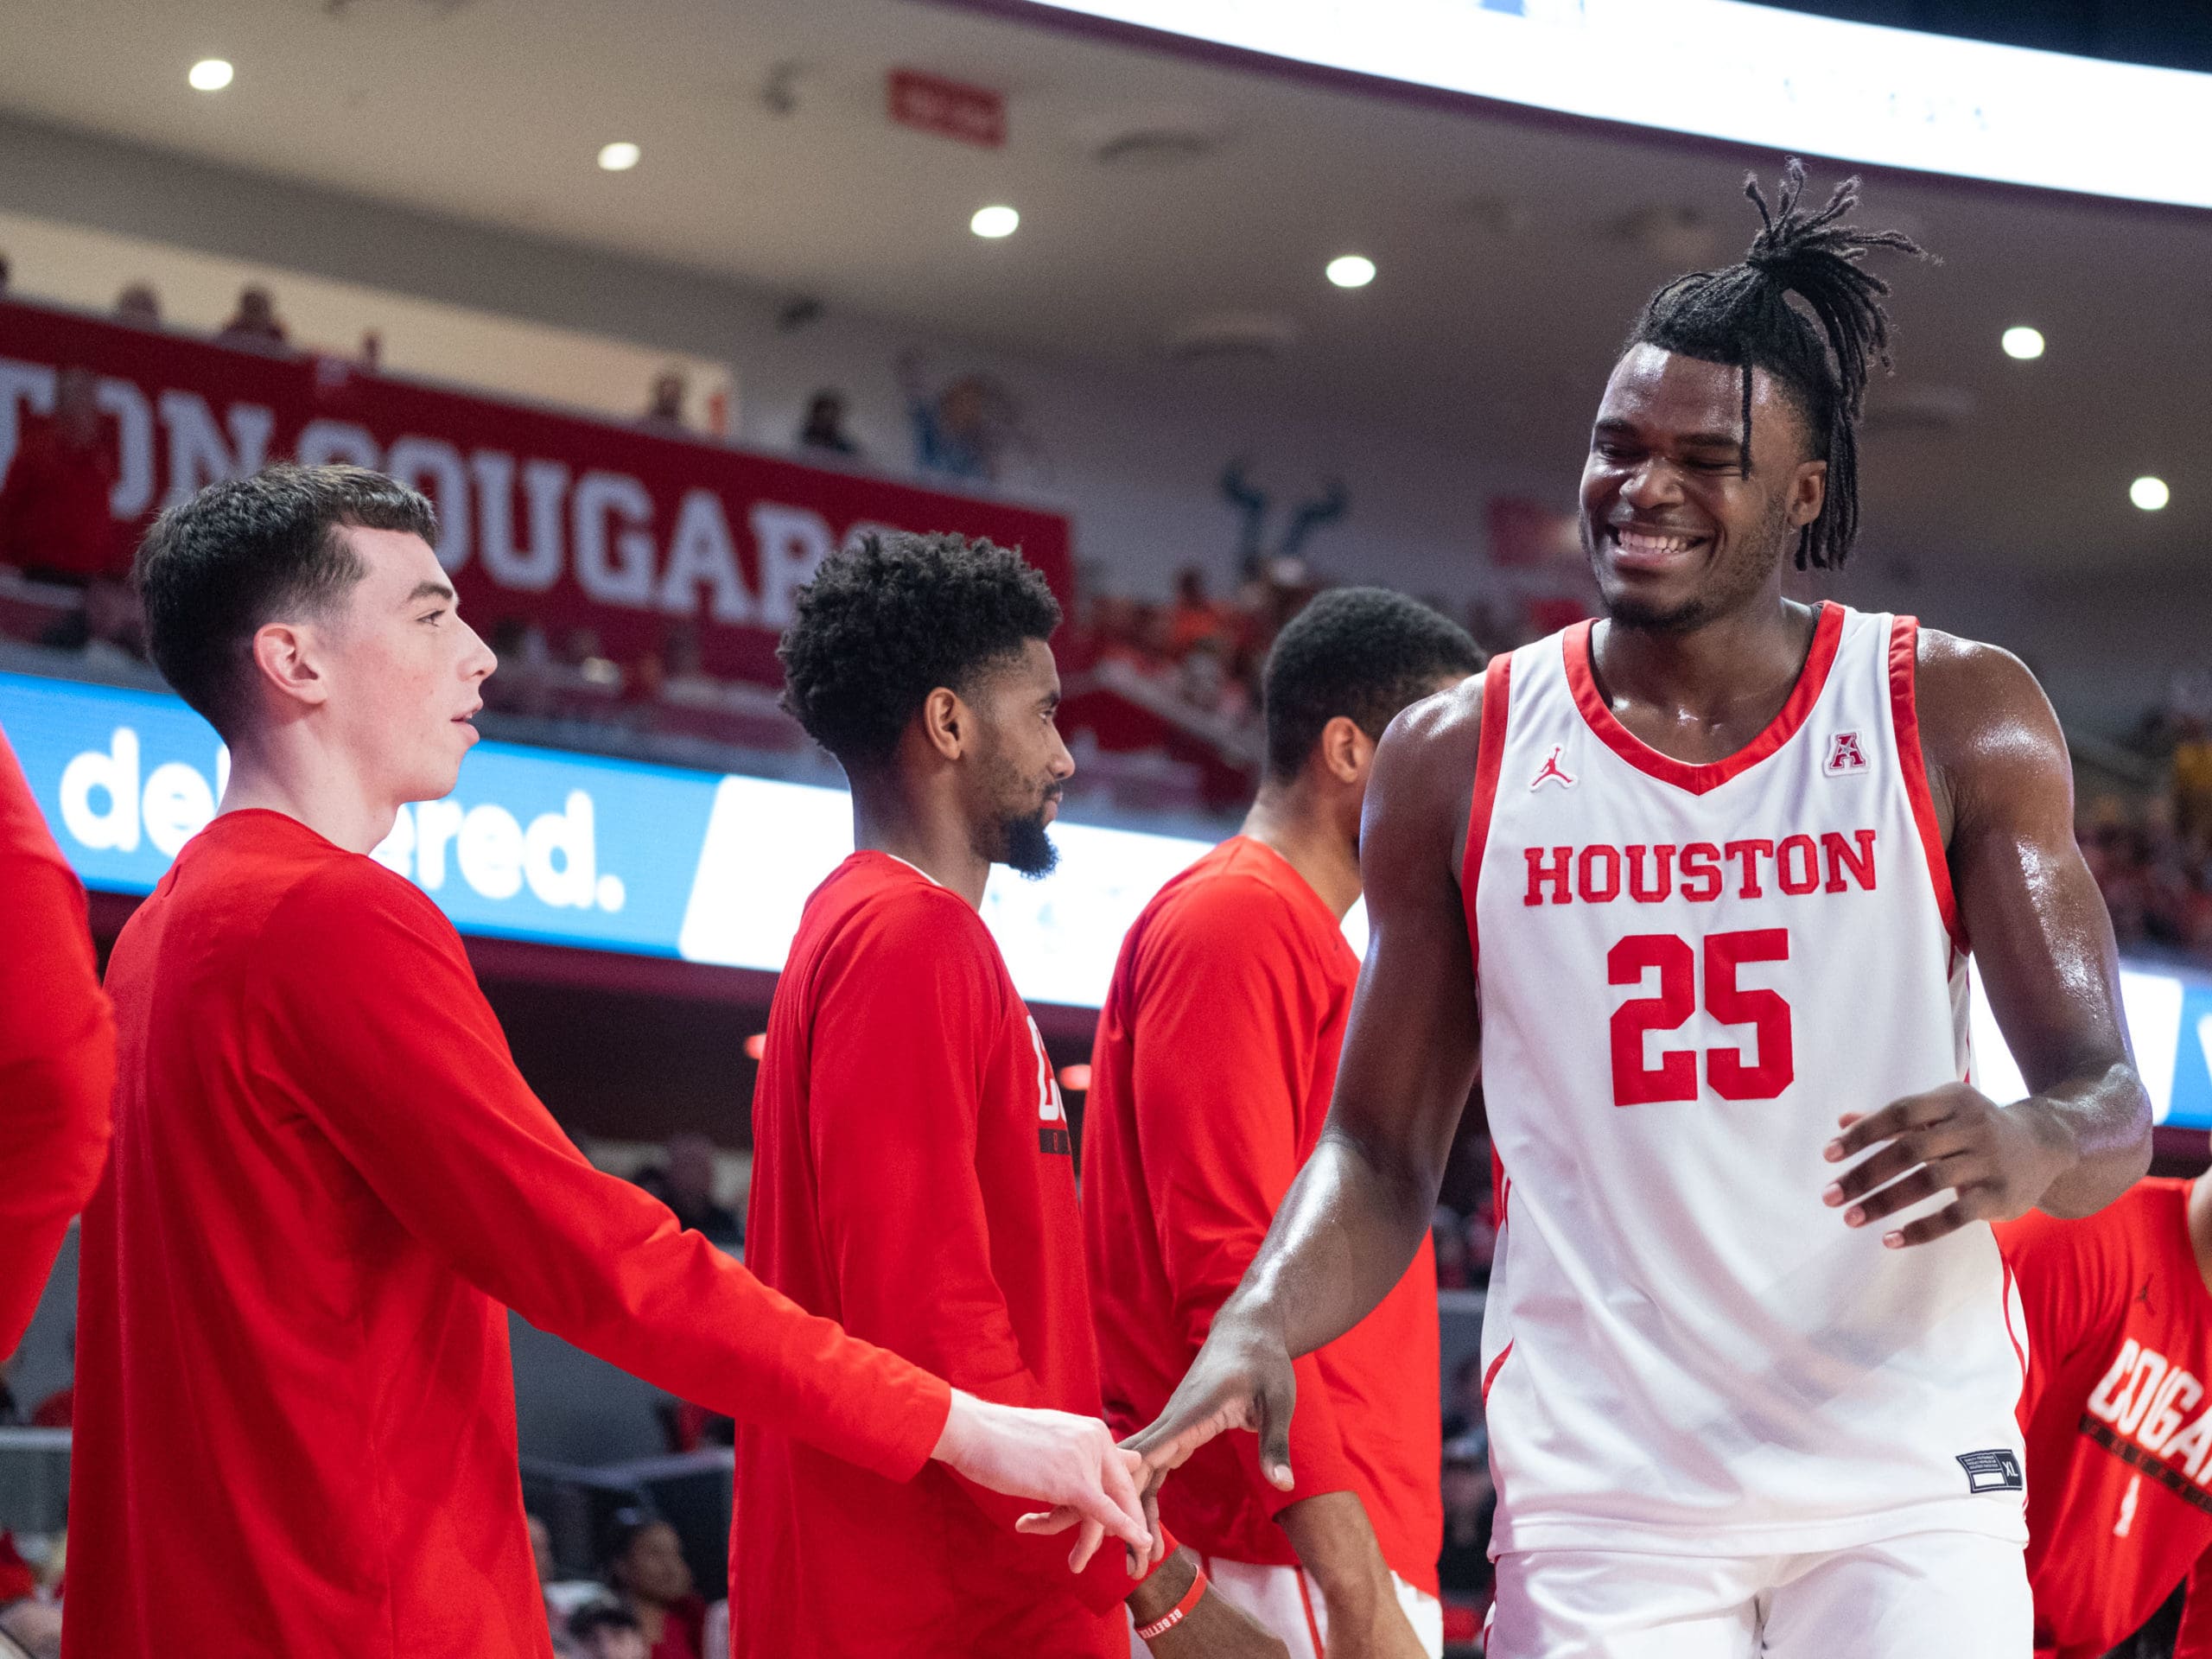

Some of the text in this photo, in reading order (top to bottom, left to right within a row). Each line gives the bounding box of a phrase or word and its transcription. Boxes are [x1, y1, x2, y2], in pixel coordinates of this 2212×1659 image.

[1523, 830, 1876, 906] HOUSTON
[1607, 928, 1795, 1106] 25
[2001, 1460, 2019, 1478] XL
[1168, 1608, 1184, 1624] BE
